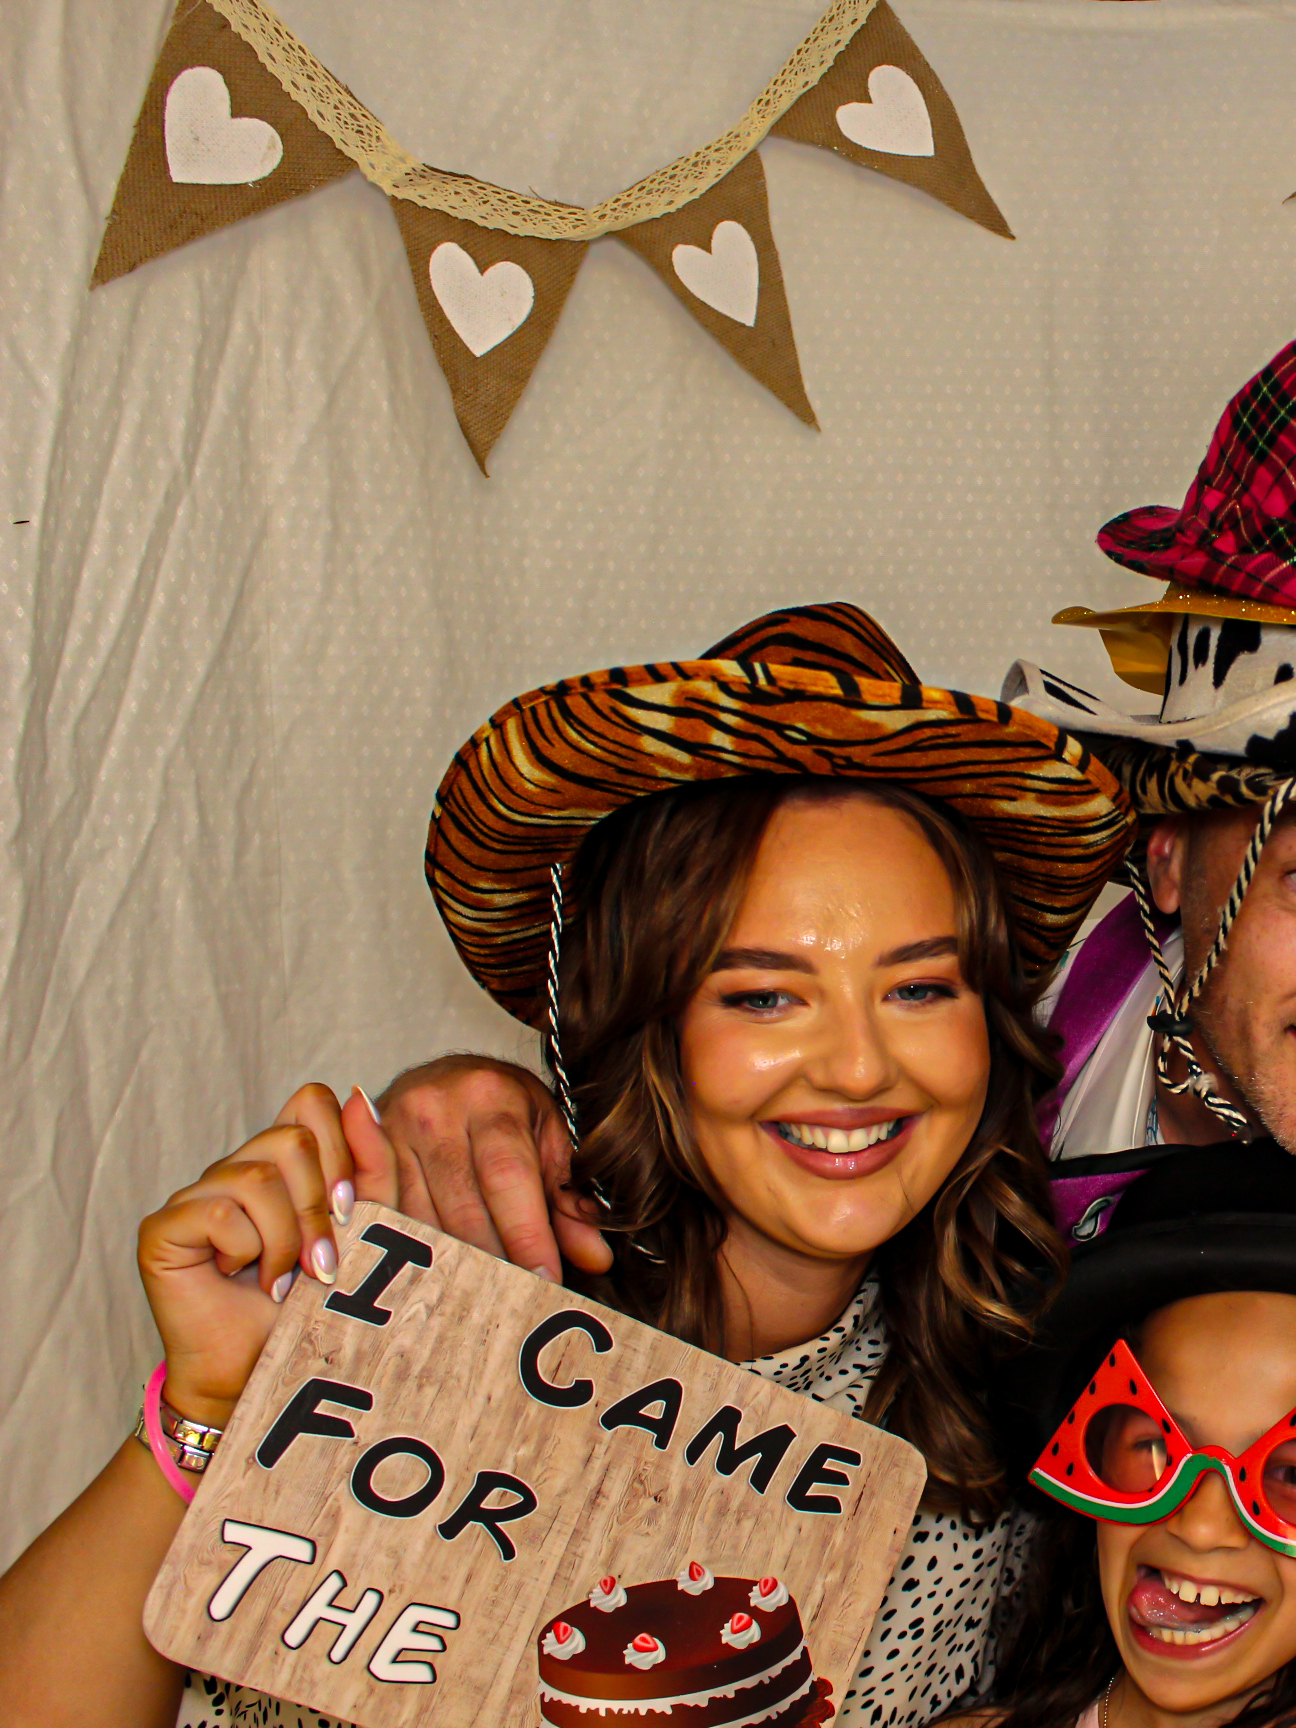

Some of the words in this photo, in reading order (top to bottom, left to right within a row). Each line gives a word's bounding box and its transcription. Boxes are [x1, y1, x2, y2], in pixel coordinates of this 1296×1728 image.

[324, 1222, 433, 1326] I
[518, 1309, 862, 1515] CAME
[255, 1377, 538, 1562] FOR
[207, 1519, 461, 1685] THE
